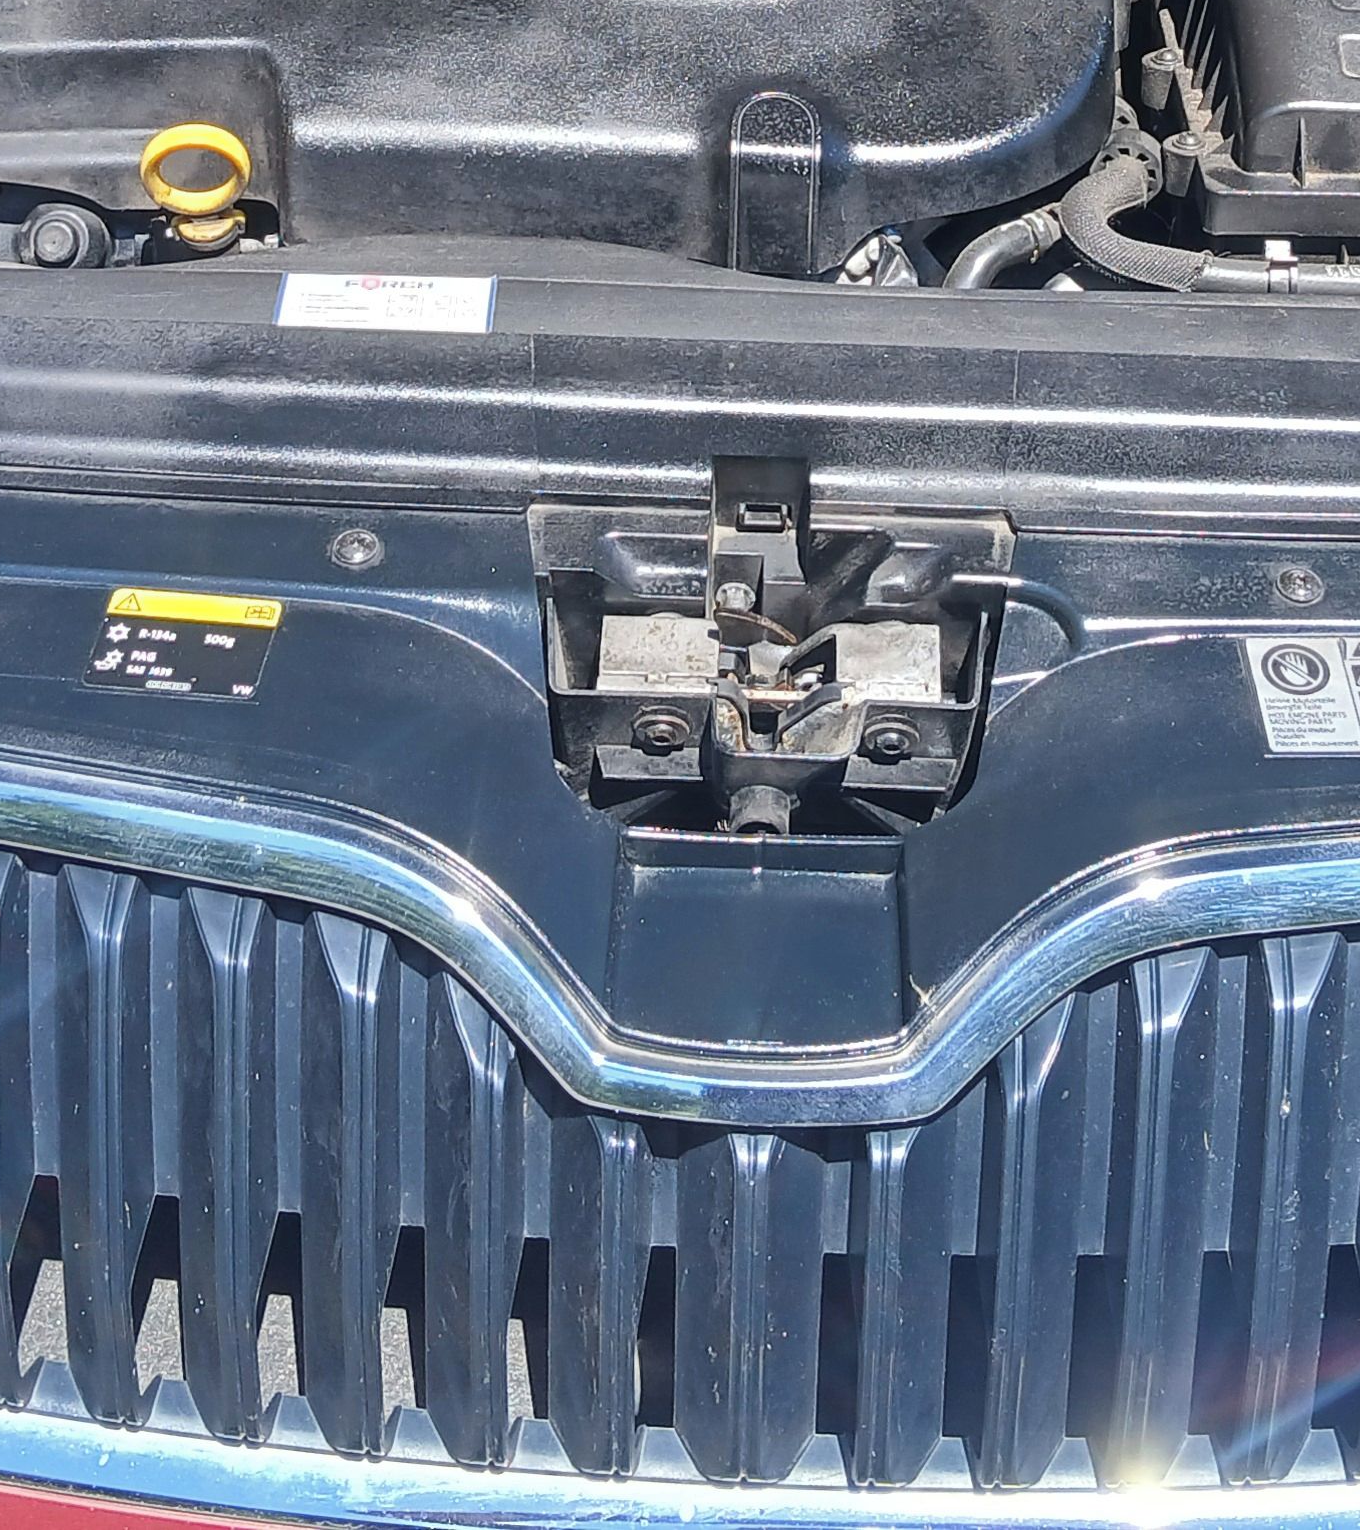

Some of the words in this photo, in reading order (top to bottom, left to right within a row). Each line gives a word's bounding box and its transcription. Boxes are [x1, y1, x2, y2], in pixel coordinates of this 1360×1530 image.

[131, 650, 158, 663] PAG
[126, 665, 146, 676] SAE
[232, 684, 254, 696] VW
